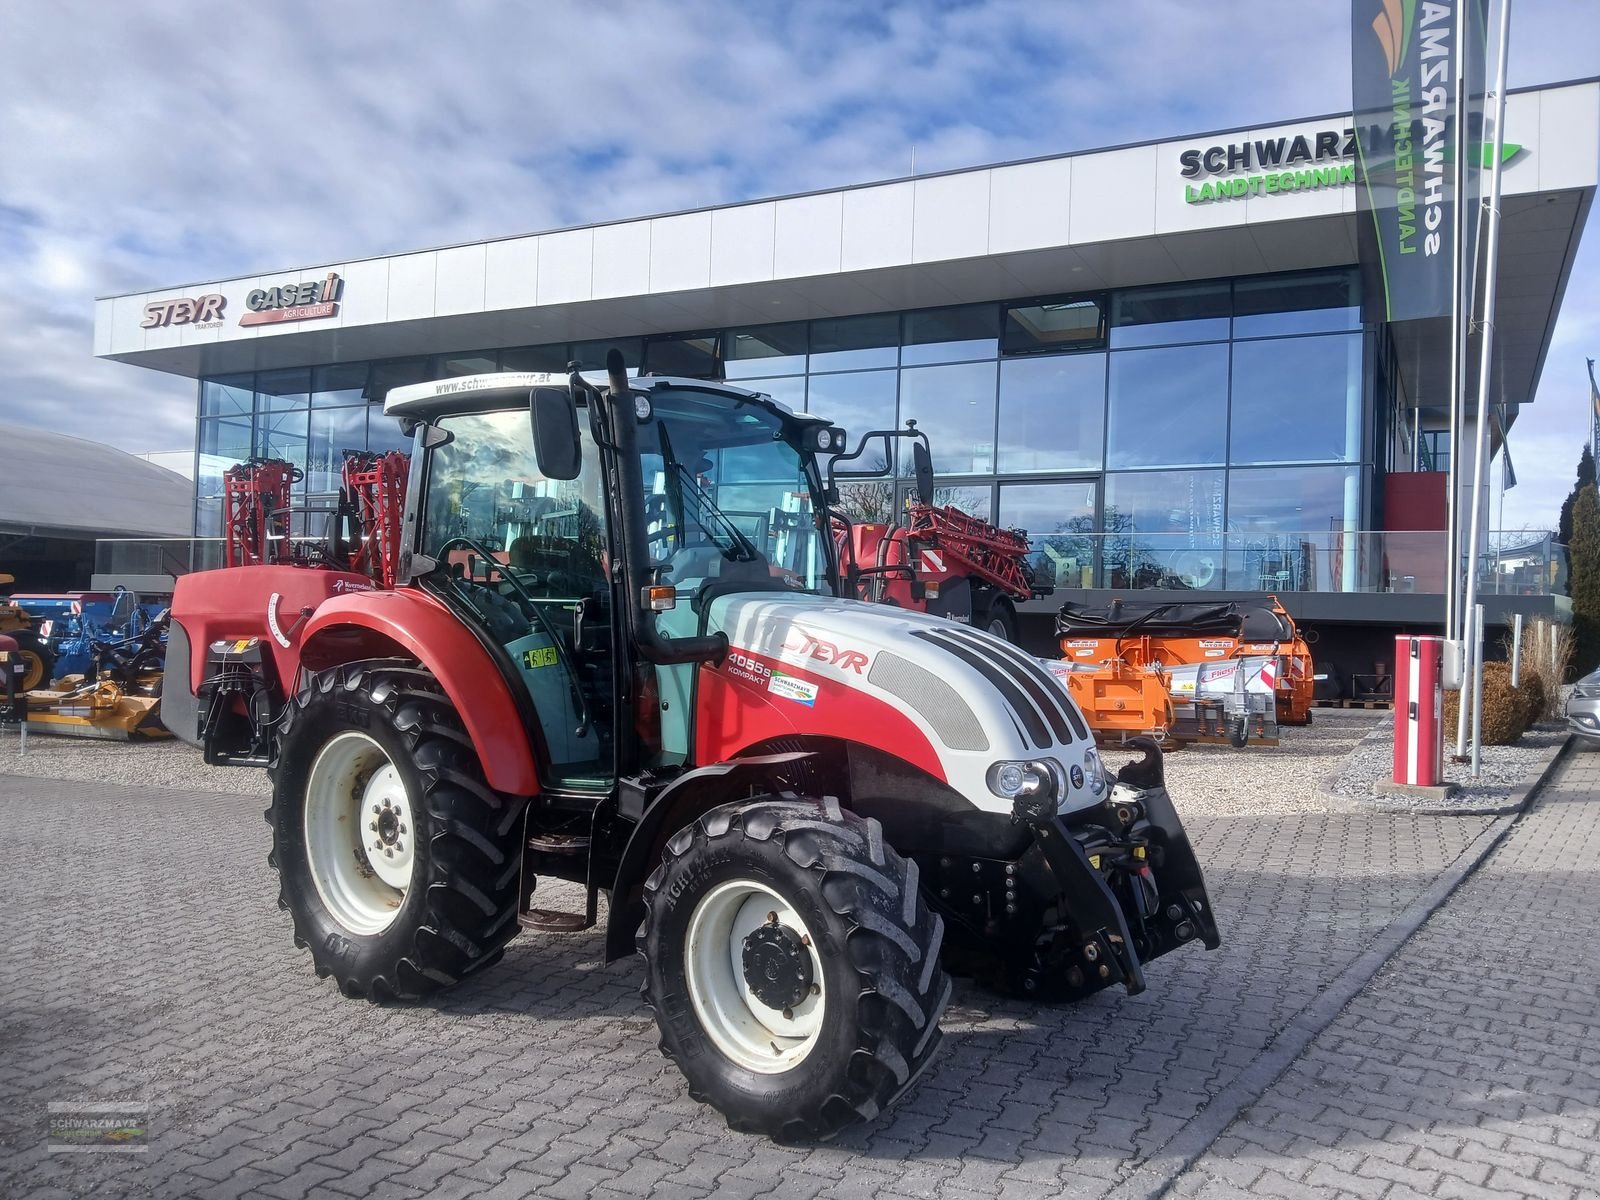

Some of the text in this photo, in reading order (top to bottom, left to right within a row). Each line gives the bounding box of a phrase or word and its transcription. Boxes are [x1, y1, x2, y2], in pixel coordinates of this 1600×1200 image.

[1185, 164, 1356, 204] LANDTECHNIK
[140, 294, 227, 328] STEYR
[282, 304, 332, 319] AGRICULTURE
[727, 666, 766, 686] KOMPAKT
